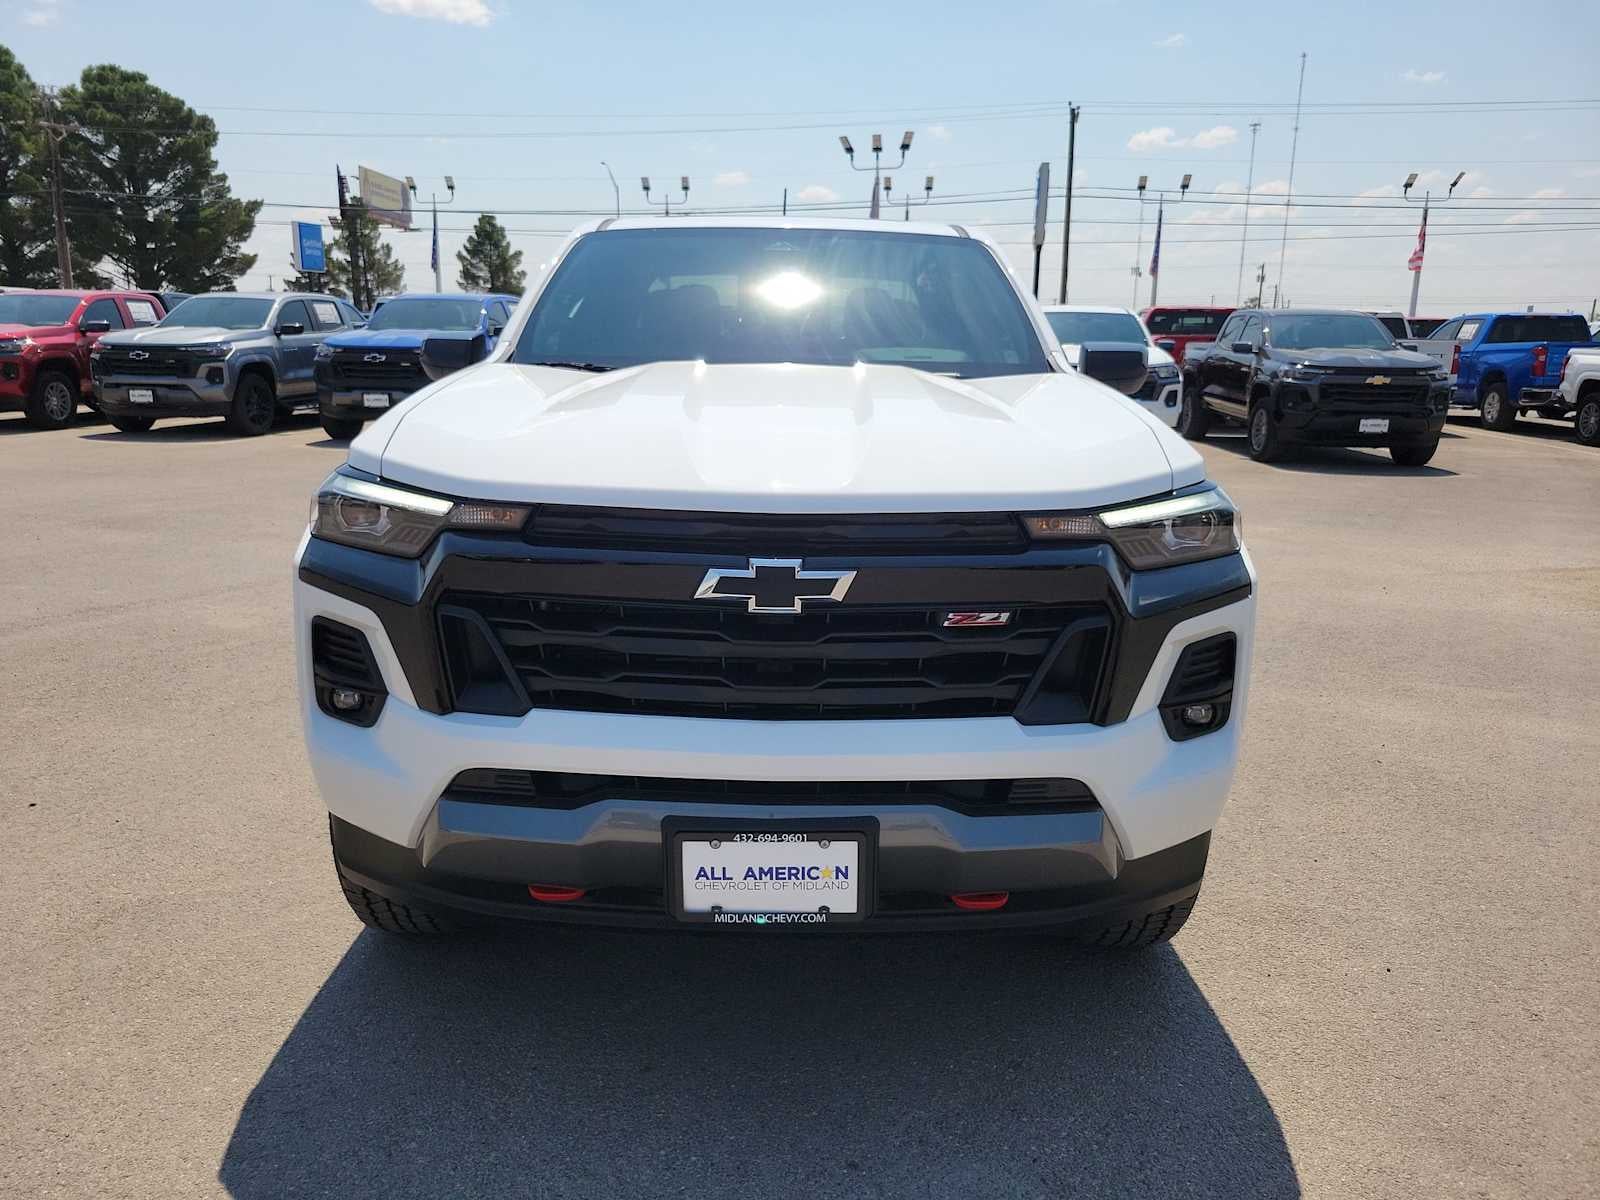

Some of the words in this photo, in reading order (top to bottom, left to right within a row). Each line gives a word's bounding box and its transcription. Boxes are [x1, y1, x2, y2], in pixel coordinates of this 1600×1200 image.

[943, 612, 1010, 627] Z71
[733, 833, 808, 843] 432-694-9601
[695, 866, 734, 881] ALL
[743, 865, 849, 881] AMERICN
[694, 881, 769, 891] CHEVROLET
[772, 881, 790, 891] OF
[792, 880, 850, 891] MIDLAND
[714, 912, 827, 924] MIDLANDCHEVY.COM
